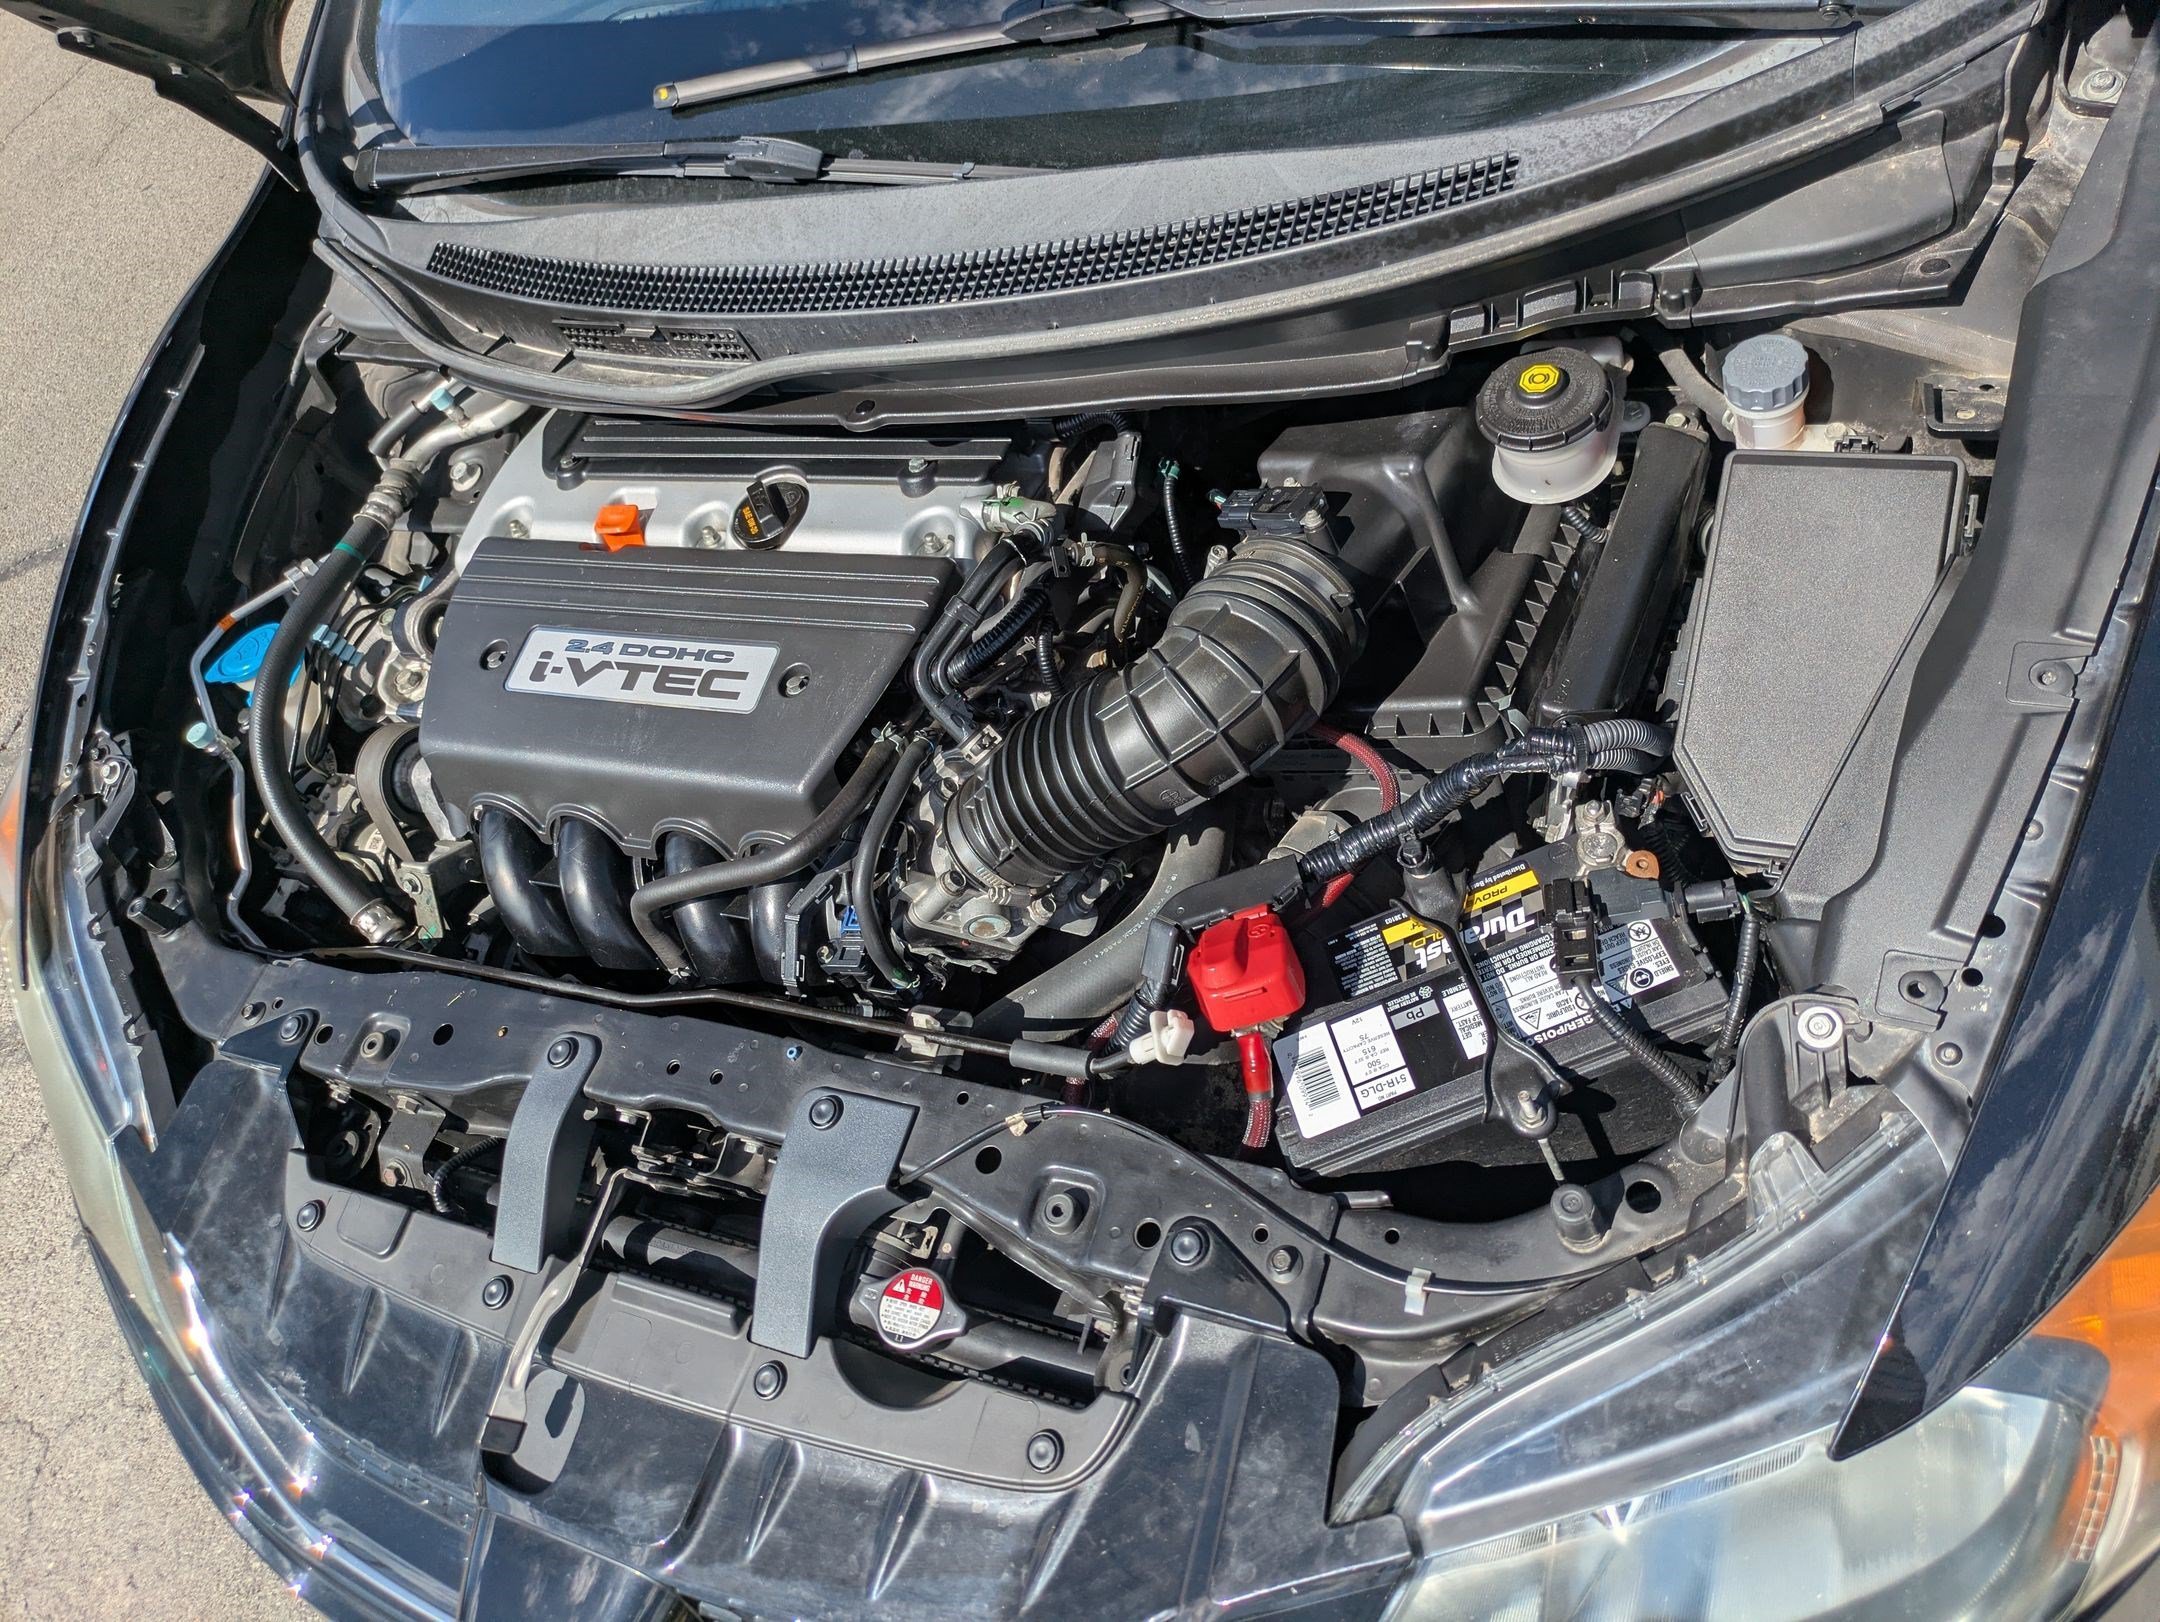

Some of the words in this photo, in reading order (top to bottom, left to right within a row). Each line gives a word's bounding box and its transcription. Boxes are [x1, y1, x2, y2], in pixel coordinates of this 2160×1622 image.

[565, 639, 614, 655] 2.4
[619, 644, 735, 663] DOHC
[529, 650, 749, 700] i-VTEC
[1491, 862, 1525, 881] Distributed
[1483, 875, 1493, 884] by
[1384, 913, 1402, 924] 38103
[1411, 904, 1536, 970] Duraast
[1518, 933, 1550, 951] CHARGING
[1514, 940, 1553, 960] COMMENDED
[1501, 955, 1515, 965] FOR
[1504, 957, 1529, 971] BURNS.
[1528, 953, 1538, 962] OR
[1635, 949, 1666, 967] EXPLOSIVE
[1475, 960, 1502, 976] INVERTE
[1495, 966, 1505, 975] DO
[1616, 961, 1636, 974] GASES
[1652, 963, 1674, 978] SHIELD
[1554, 997, 1569, 1008] ACID
[1404, 1006, 1425, 1022] Pb
[1545, 1004, 1573, 1020] SULFURIC
[1350, 1016, 1363, 1025] 12V
[1457, 1019, 1482, 1034] MEDICAL
[1358, 1032, 1369, 1041] 75
[1460, 1030, 1472, 1039] GET
[1360, 1044, 1376, 1055] 615
[1365, 1057, 1382, 1069] 500
[1359, 1072, 1407, 1099] 51R-DLG
[910, 1273, 933, 1285] DANGER
